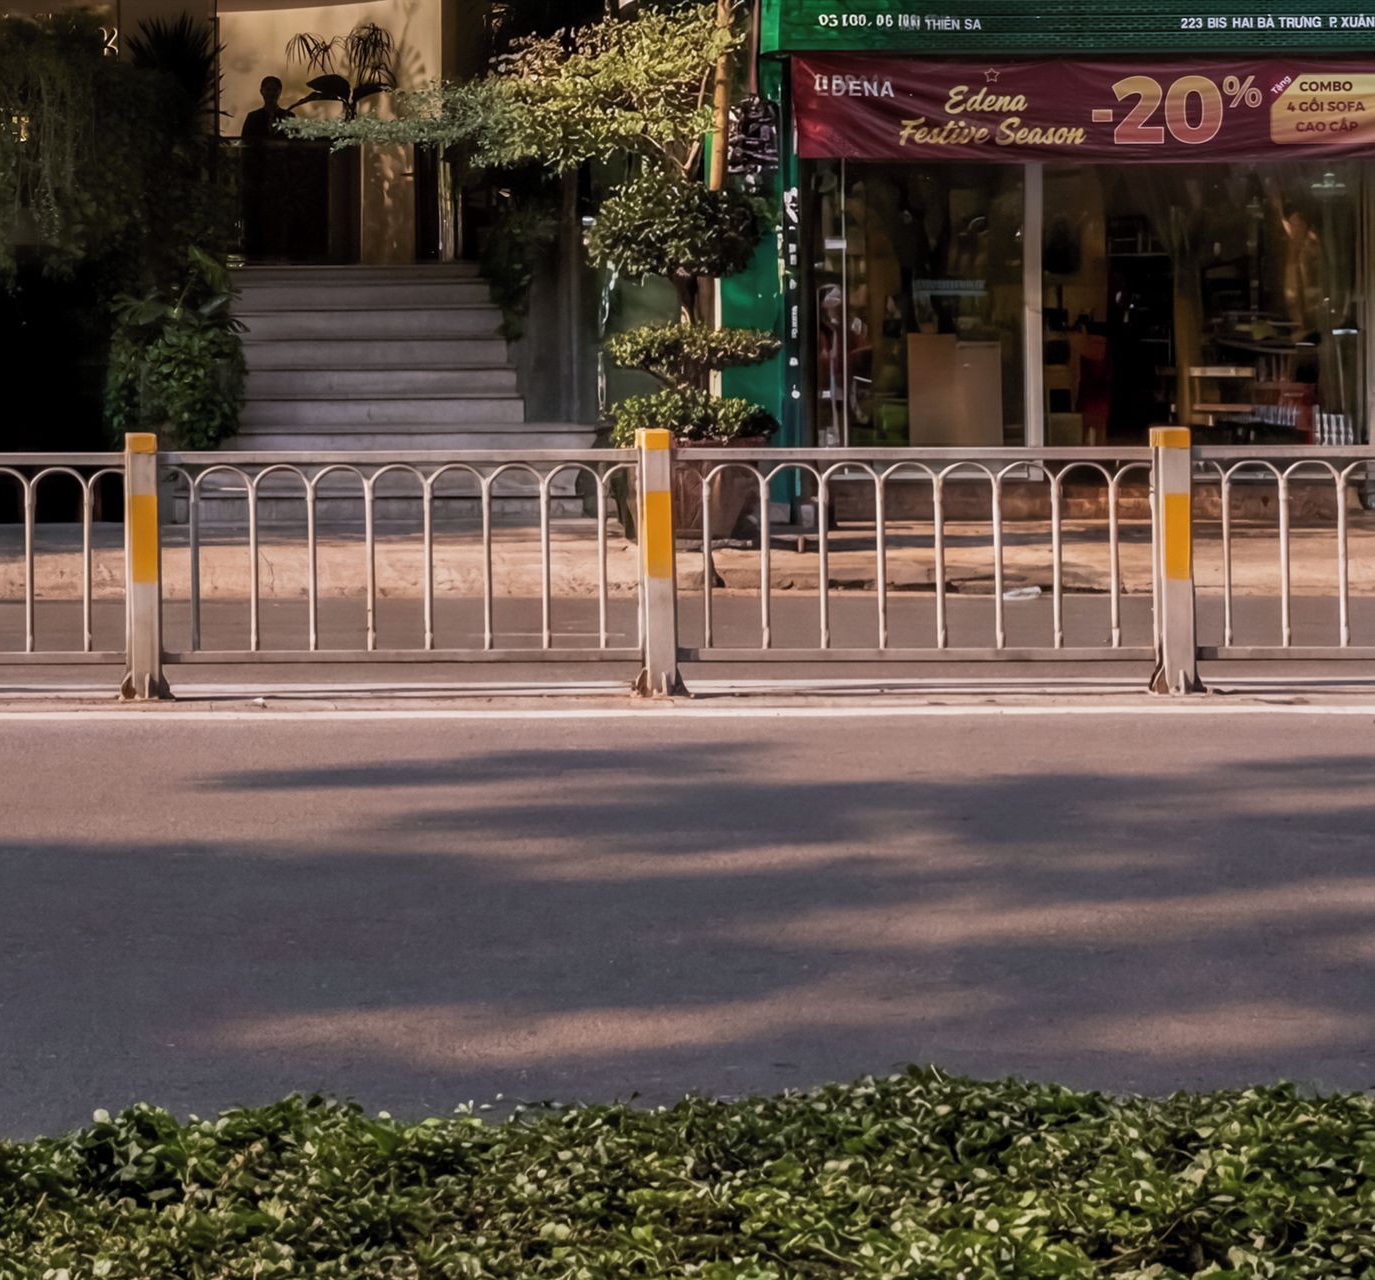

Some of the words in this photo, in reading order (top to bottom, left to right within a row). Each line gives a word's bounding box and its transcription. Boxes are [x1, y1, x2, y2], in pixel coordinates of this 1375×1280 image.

[964, 19, 982, 30] SA
[1181, 17, 1203, 29] 223
[1207, 17, 1227, 28] BIS
[1232, 16, 1253, 28] HAI
[1257, 14, 1275, 28] BÀ
[1279, 15, 1322, 28] TRƯNG
[1329, 16, 1338, 28] P.
[1299, 81, 1353, 92] COMBO
[945, 85, 1028, 114] Edena
[1287, 102, 1296, 112] 4
[1327, 101, 1365, 112] SOFA
[898, 116, 990, 146] Festive
[995, 116, 1086, 146] Season
[1296, 122, 1326, 132] CAO
